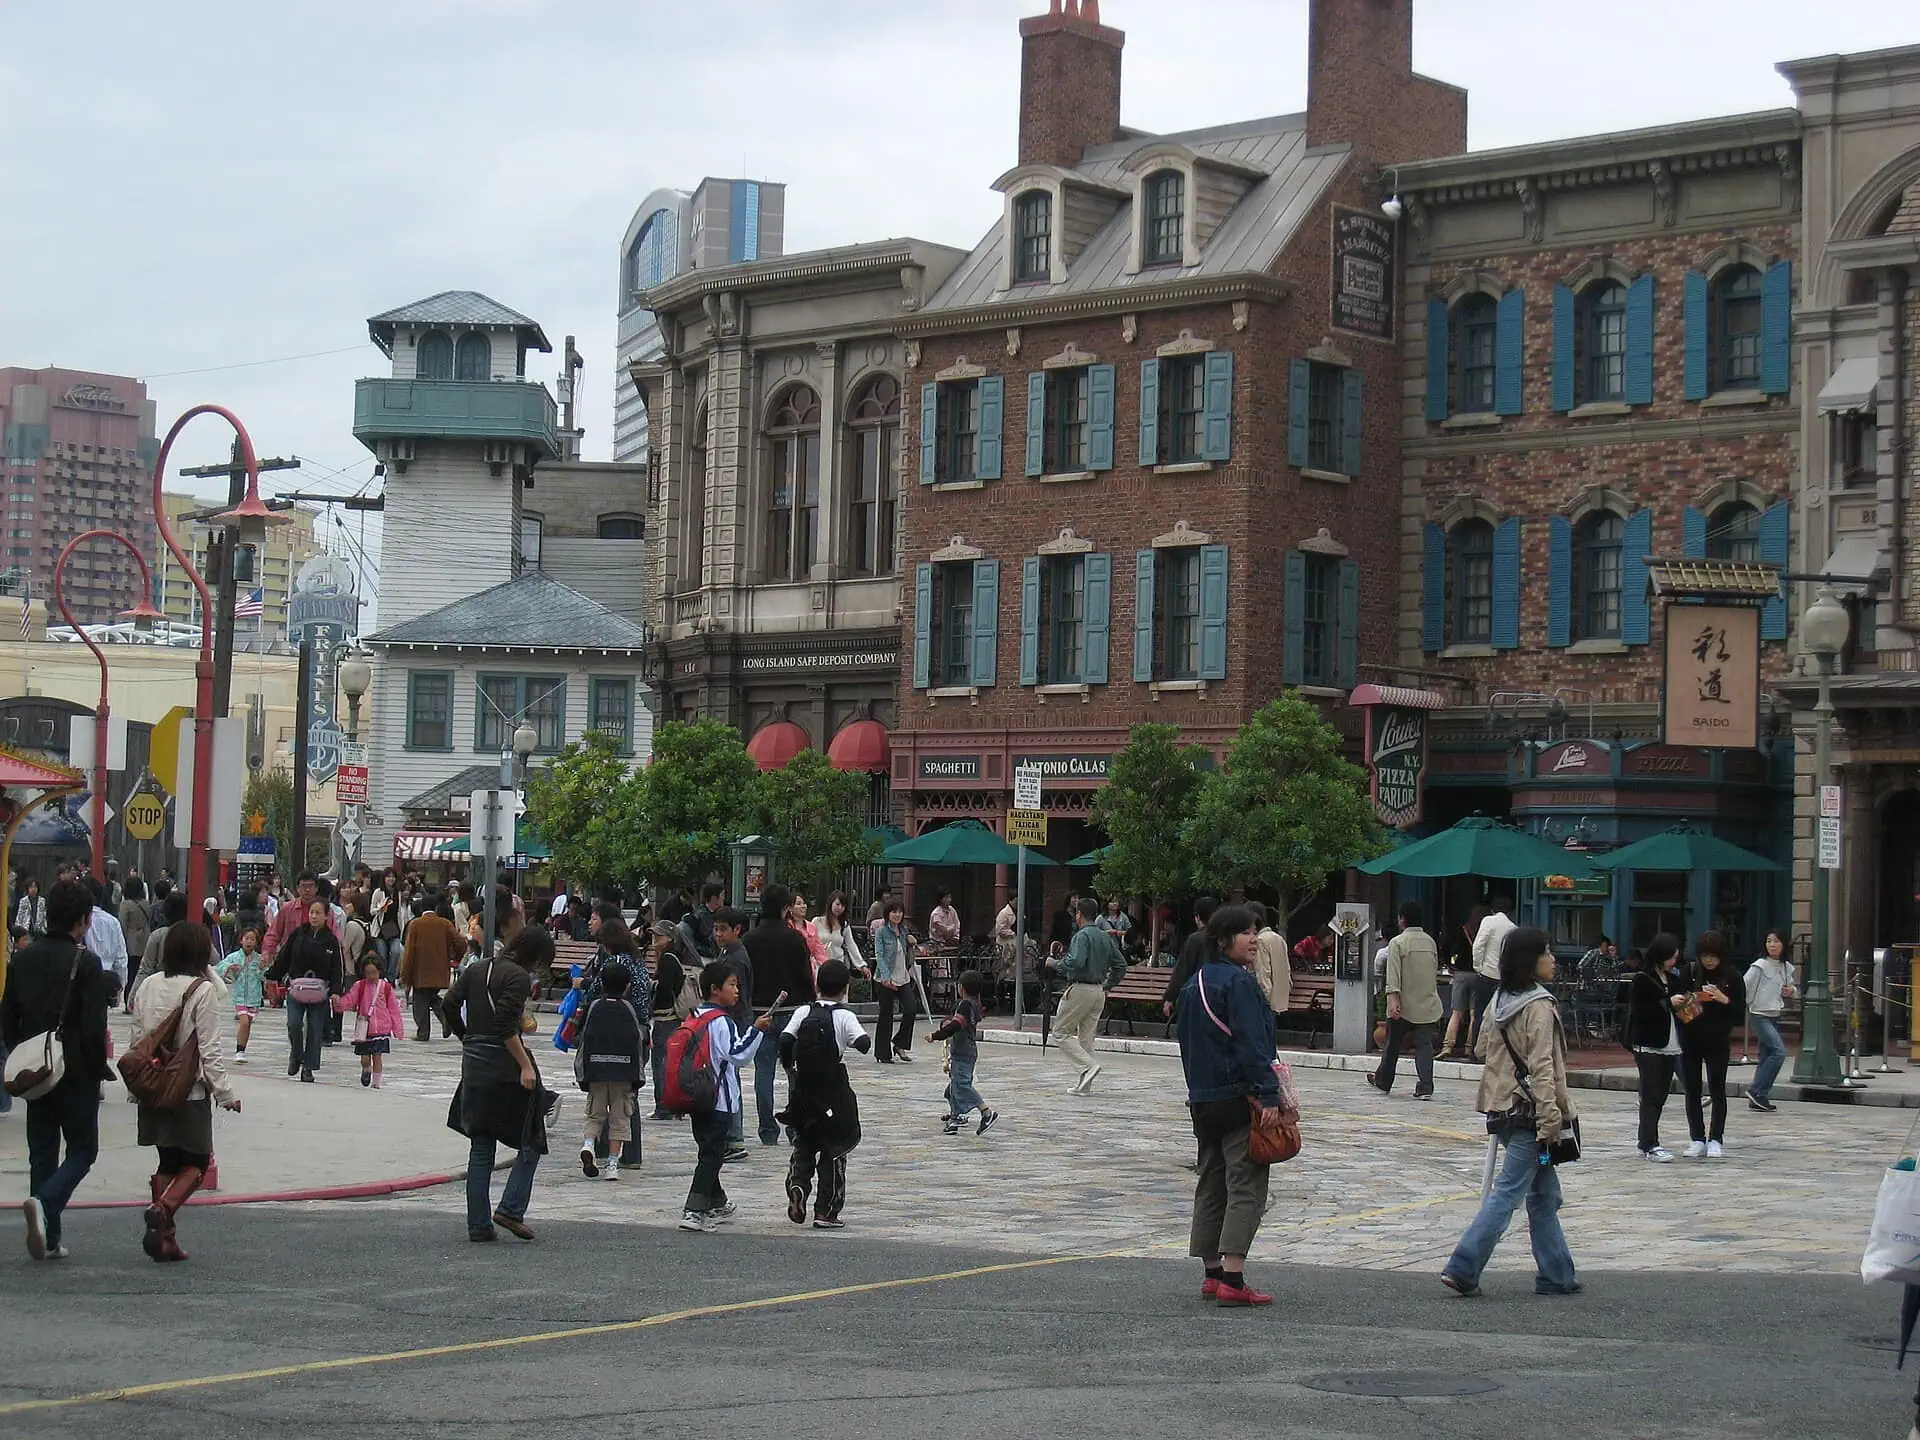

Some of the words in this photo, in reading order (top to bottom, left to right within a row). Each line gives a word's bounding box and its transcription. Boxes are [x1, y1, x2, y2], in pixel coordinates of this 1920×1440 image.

[743, 658, 765, 669] LONG
[766, 657, 796, 668] ISLAND
[797, 656, 818, 667] SAFE
[819, 654, 853, 666] DEPOSIT
[854, 652, 897, 664] COMPANY
[1692, 717, 1730, 727] SAIDO
[1404, 754, 1420, 768] N.Y.
[349, 768, 358, 776] NO
[925, 762, 976, 774] SPAGHETTI
[339, 775, 367, 785] STANDING
[1379, 767, 1415, 785] PIZZA
[352, 785, 366, 793] ZONE
[1379, 786, 1415, 809] PARLOR
[129, 807, 161, 825] STOP
[1009, 830, 1017, 842] NO
[1019, 830, 1045, 843] PARKING
